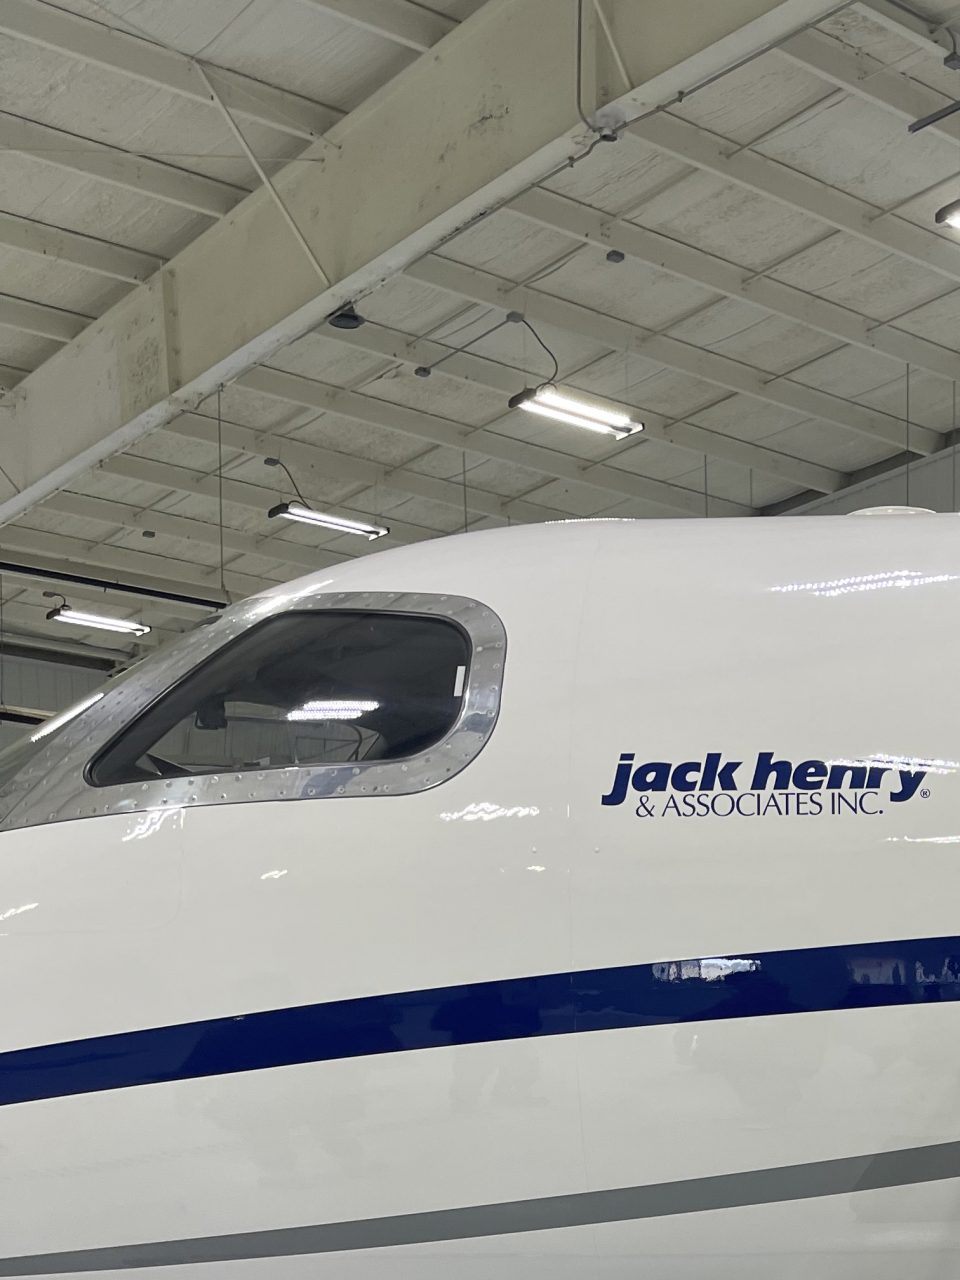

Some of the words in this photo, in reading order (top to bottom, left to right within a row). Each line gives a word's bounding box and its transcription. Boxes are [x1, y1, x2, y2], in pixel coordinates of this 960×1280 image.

[601, 752, 743, 806] jack
[635, 794, 655, 818] &
[661, 792, 823, 817] ASSOCIATES
[831, 791, 884, 815] INC.
